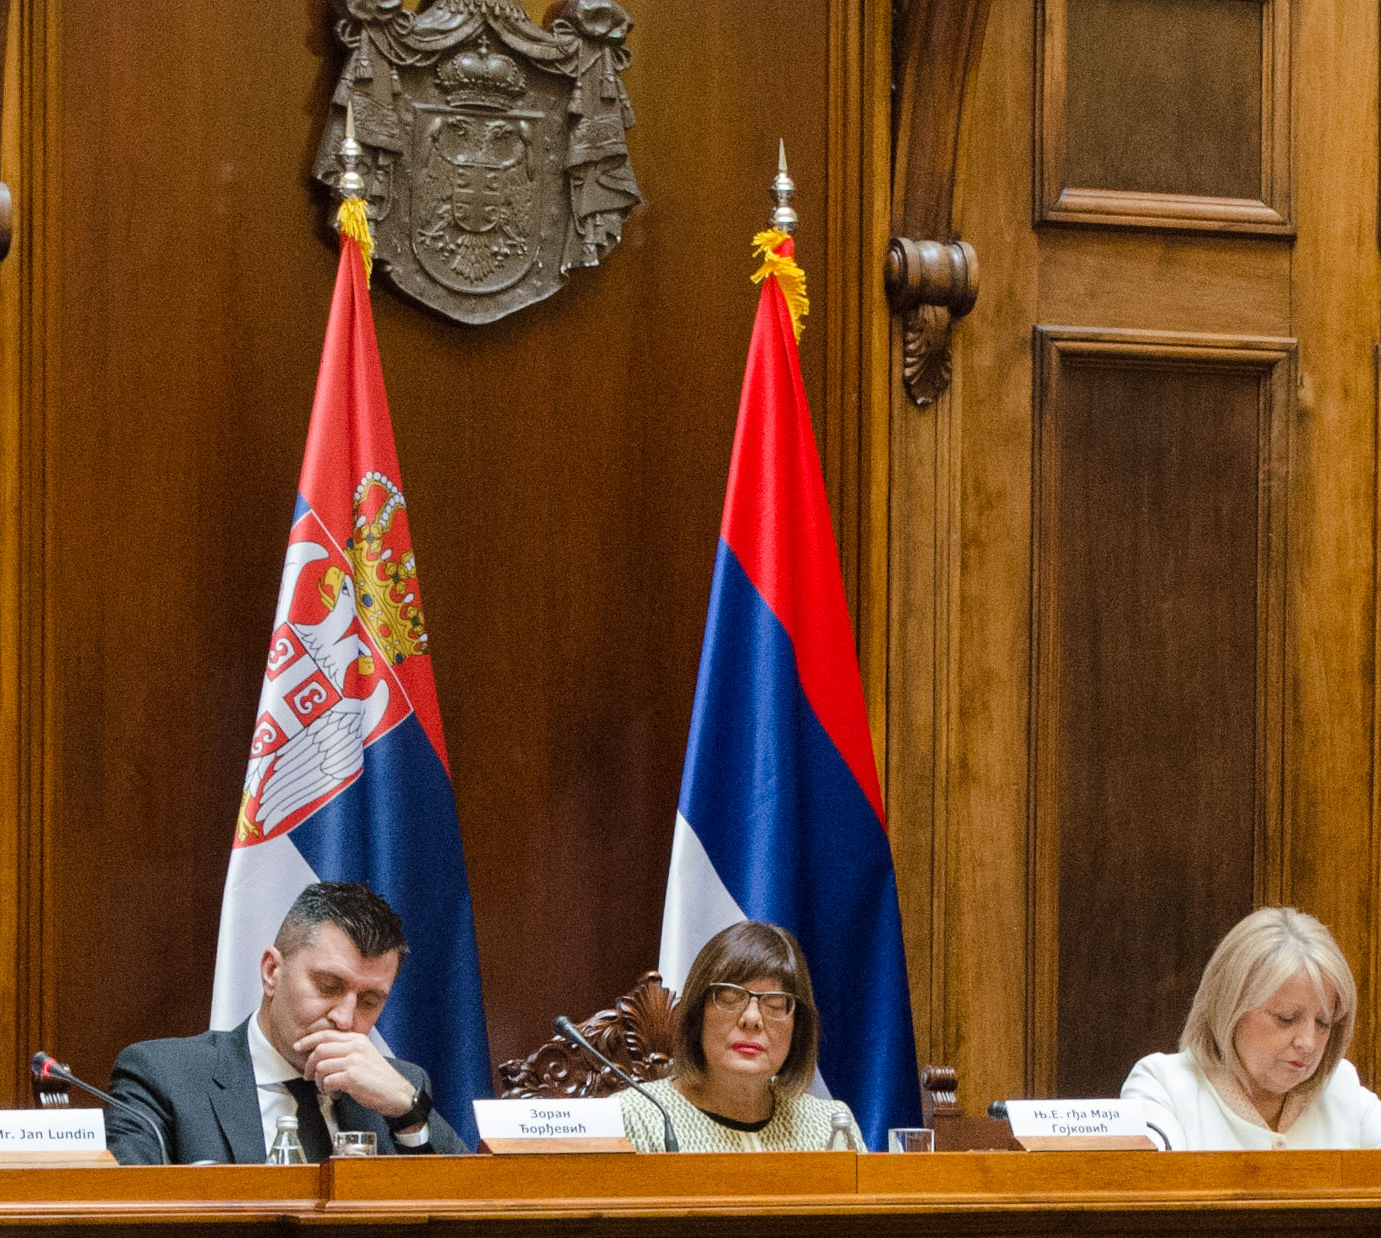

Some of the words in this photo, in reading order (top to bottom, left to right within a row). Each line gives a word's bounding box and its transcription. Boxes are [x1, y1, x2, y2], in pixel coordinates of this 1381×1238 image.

[529, 1108, 571, 1121] Зоран
[1091, 1109, 1120, 1121] Маја
[20, 1128, 43, 1140] Jan
[48, 1128, 95, 1140] Lundin
[518, 1123, 587, 1136] Ђорђевић
[1051, 1123, 1109, 1136] Гојковић
